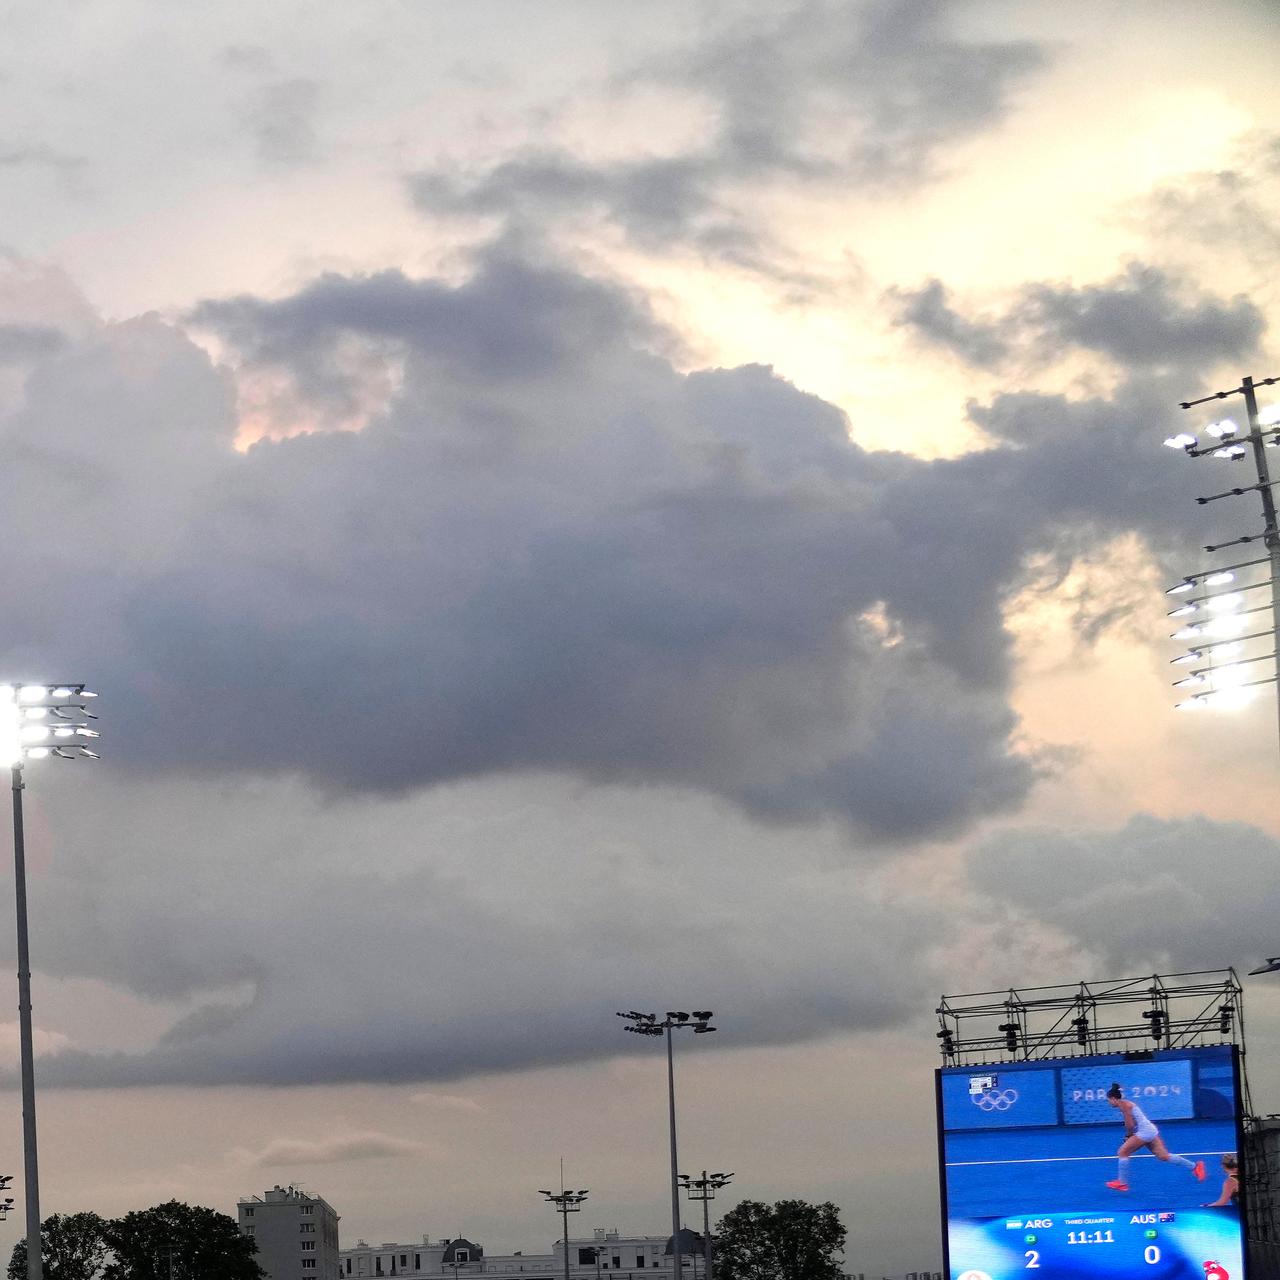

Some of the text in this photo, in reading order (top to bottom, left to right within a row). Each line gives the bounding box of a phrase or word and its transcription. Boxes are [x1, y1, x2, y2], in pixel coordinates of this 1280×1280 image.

[1073, 1085, 1181, 1102] PAR 2024
[1024, 1218, 1053, 1229] ARG
[1084, 1217, 1115, 1225] QUARTER
[1130, 1214, 1156, 1225] AUS
[1067, 1230, 1115, 1245] 11:11
[1024, 1245, 1161, 1269] 2 0
